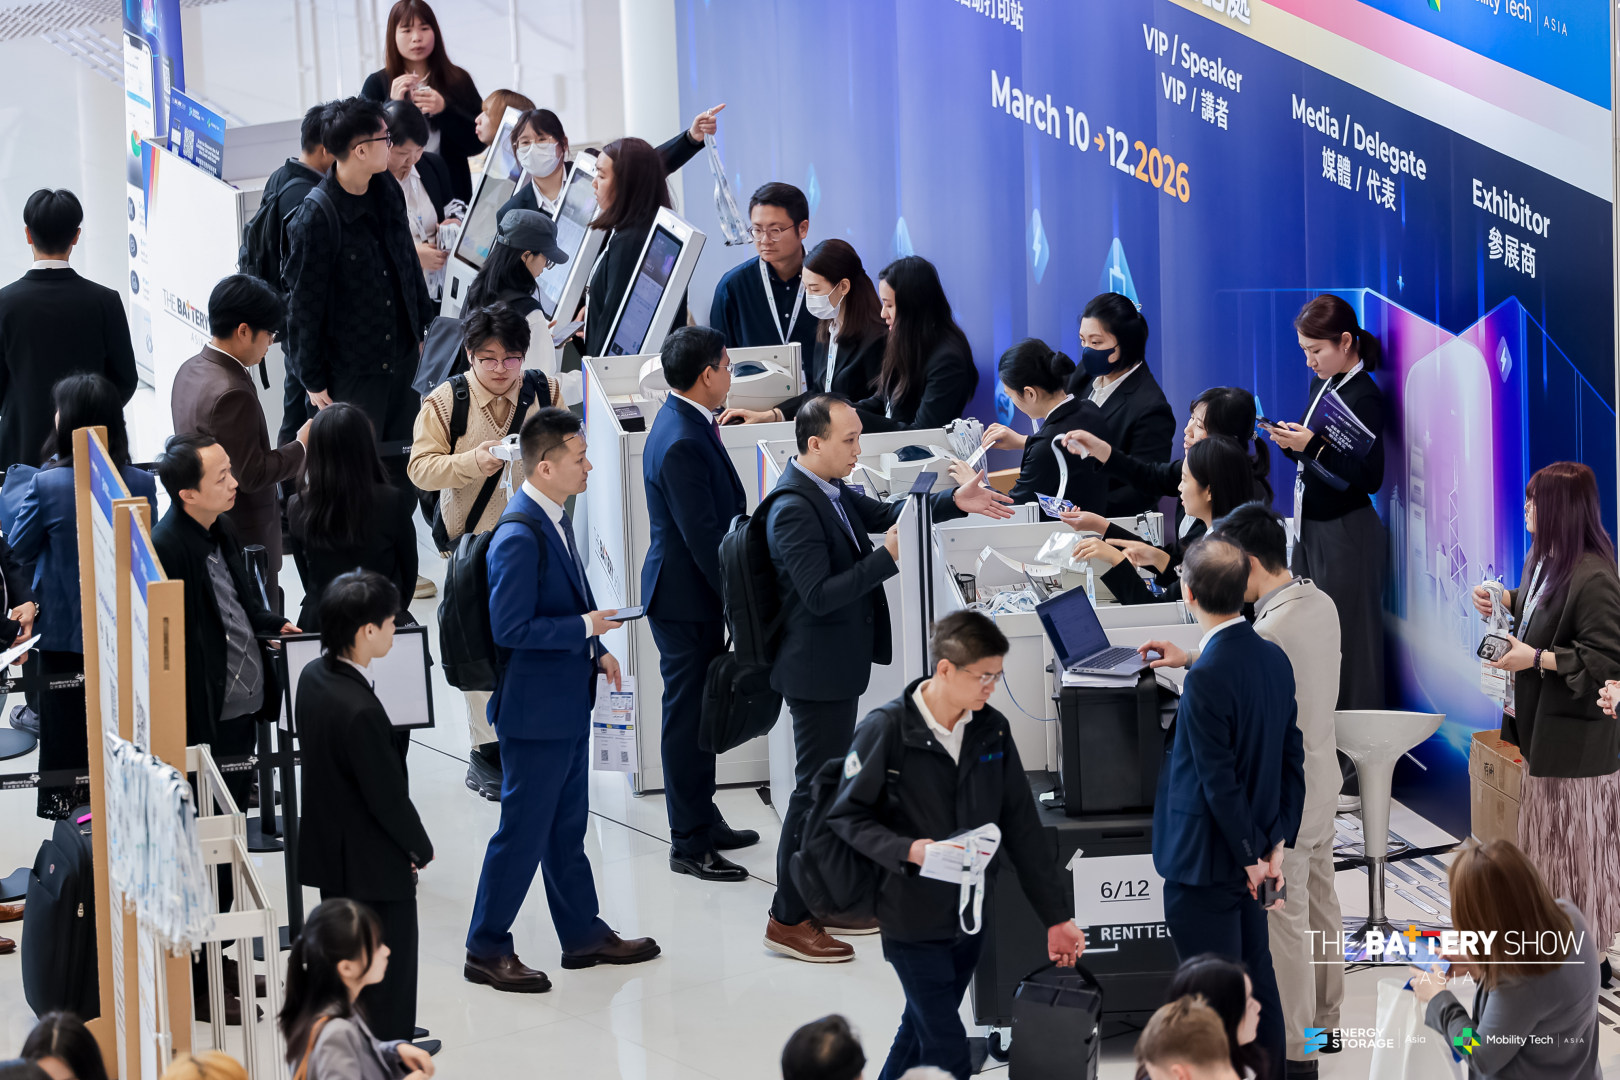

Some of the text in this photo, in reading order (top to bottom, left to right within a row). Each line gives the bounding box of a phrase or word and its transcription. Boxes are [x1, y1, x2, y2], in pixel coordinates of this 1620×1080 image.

[1543, 15, 1568, 37] ASIA
[1142, 23, 1169, 56] VIP
[1181, 42, 1243, 93] Speaker
[991, 69, 1061, 139] March
[1065, 105, 1090, 152] 10
[1161, 72, 1187, 105] VIP
[1200, 88, 1229, 131] 講者
[1292, 93, 1340, 140] Media
[1353, 122, 1427, 181] Delegate
[1321, 145, 1352, 190] 媒體
[1366, 168, 1396, 212] 代表
[1472, 177, 1551, 239] Exhibitor
[1487, 226, 1537, 279] 參展商
[162, 288, 176, 312] THE
[1100, 879, 1150, 900] 6/12
